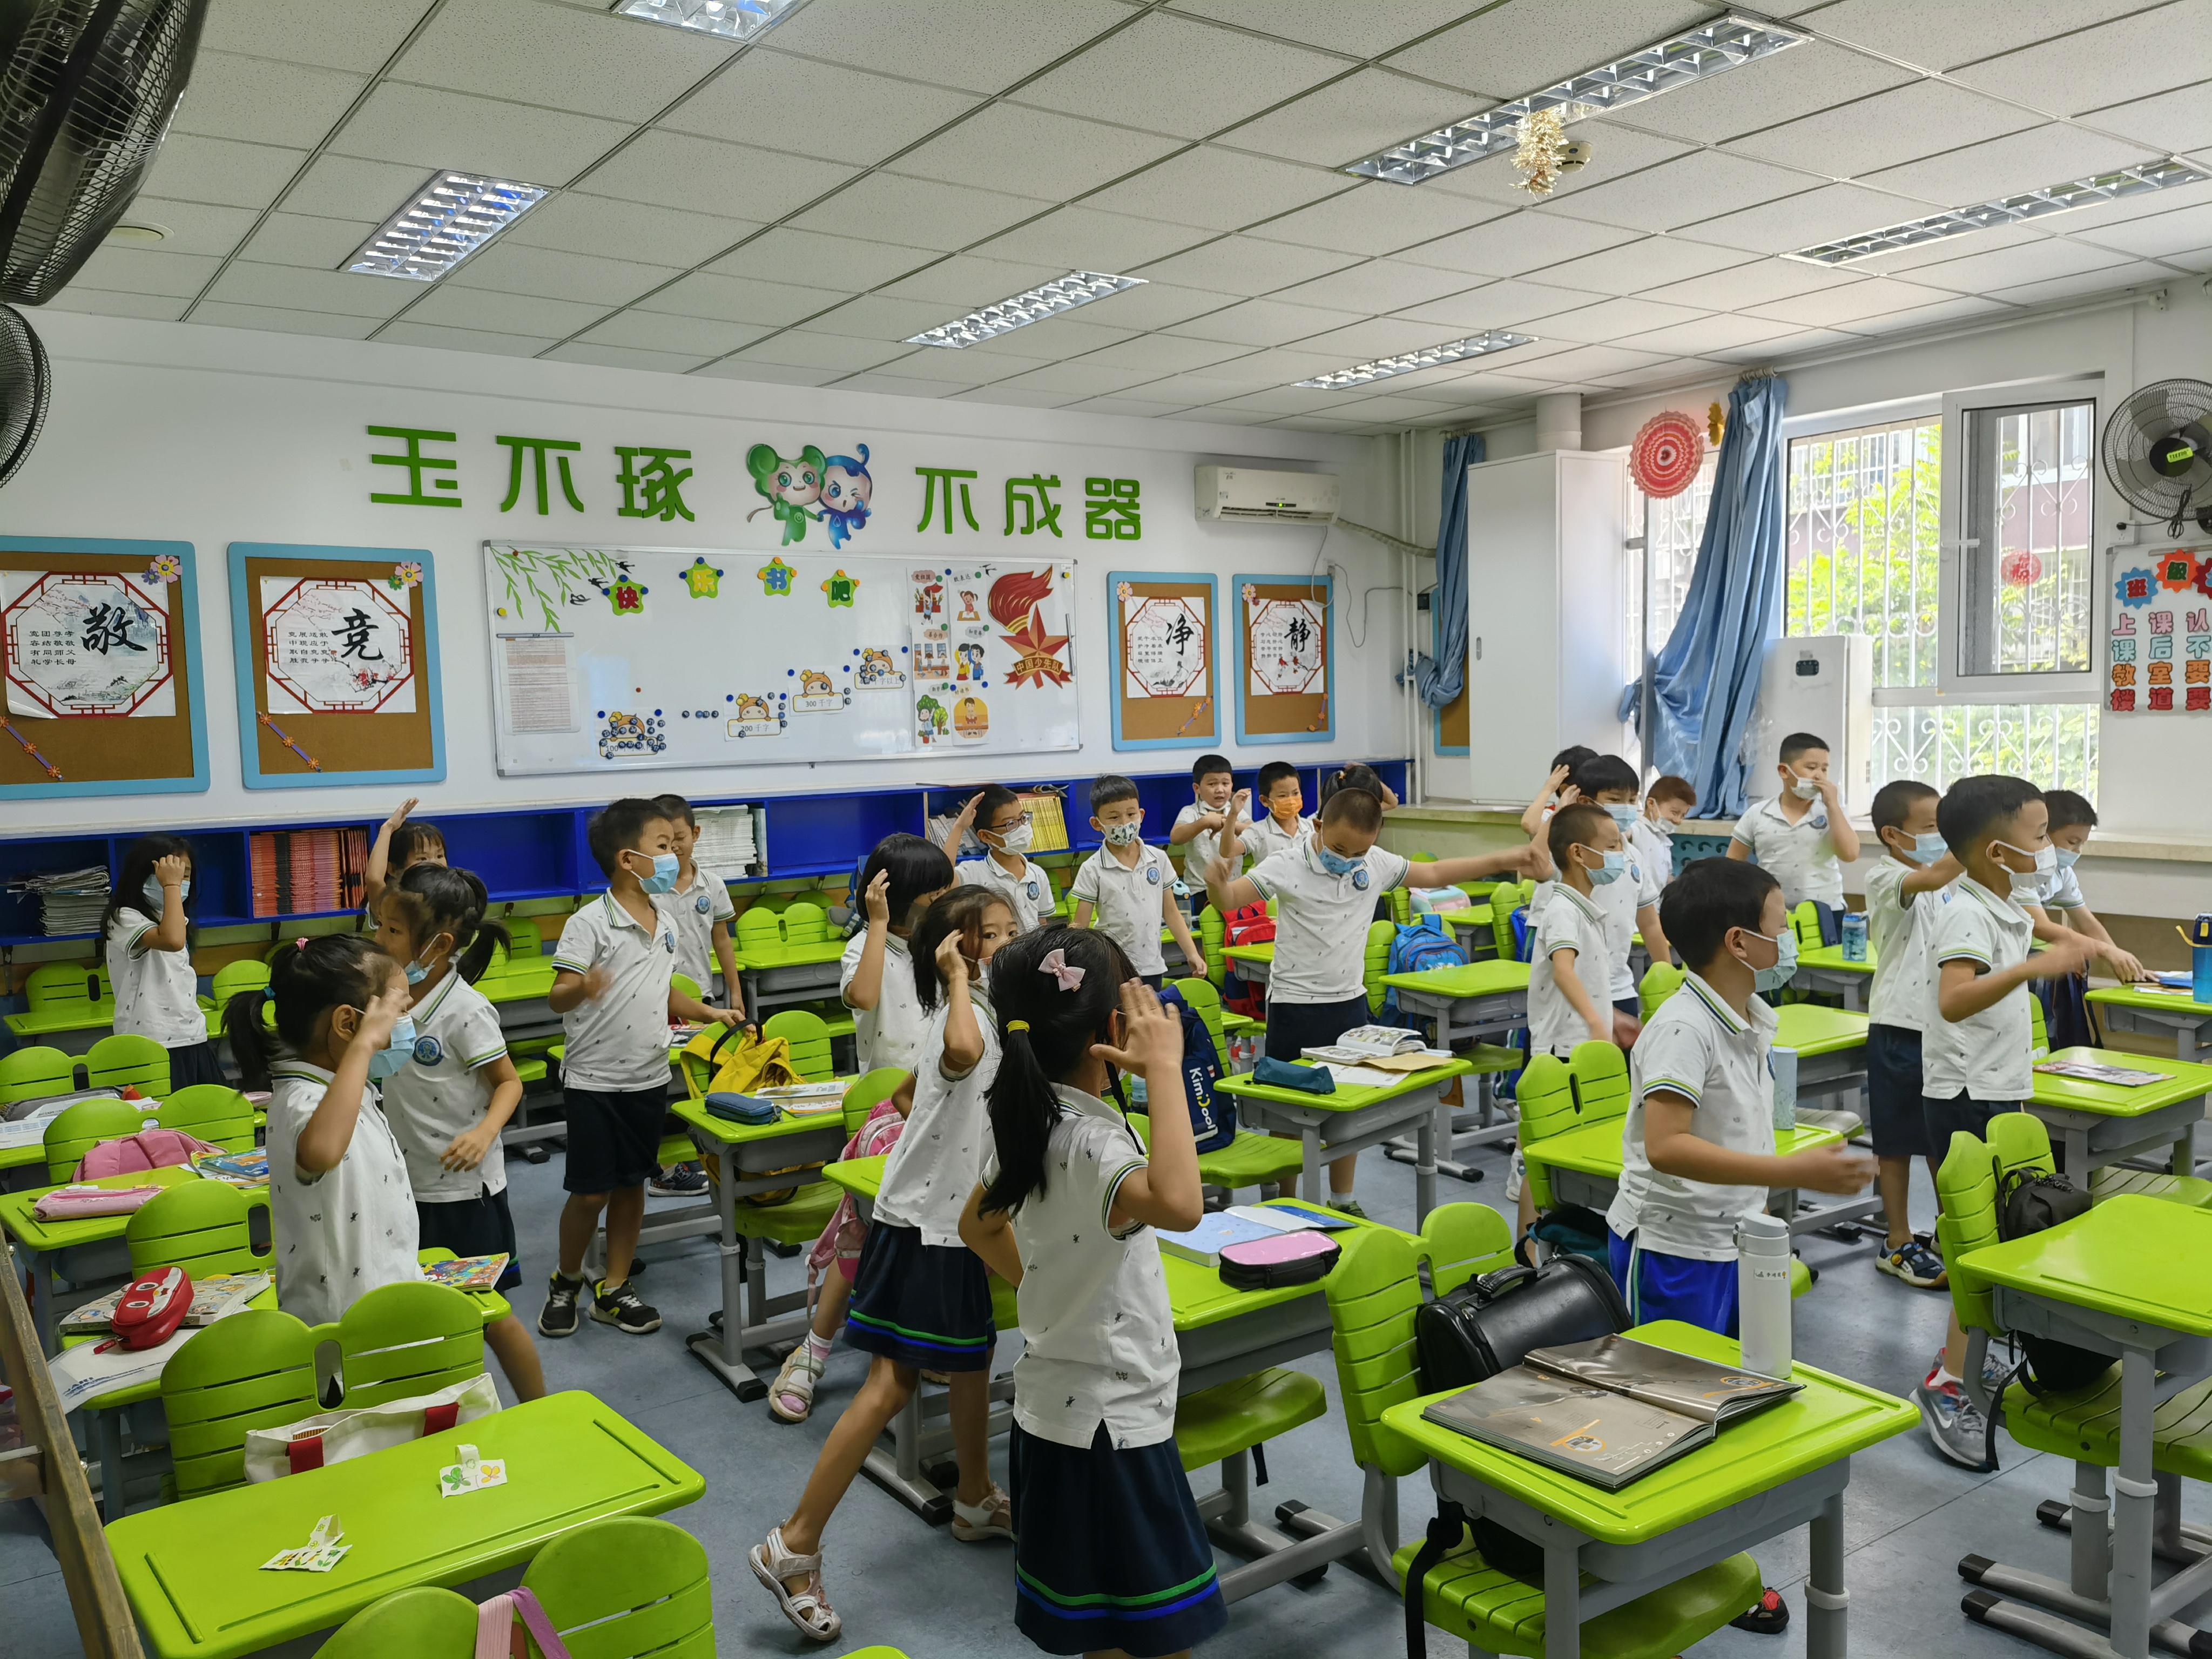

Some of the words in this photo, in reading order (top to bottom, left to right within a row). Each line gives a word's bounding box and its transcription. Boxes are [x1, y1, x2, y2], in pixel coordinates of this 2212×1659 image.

[367, 425, 694, 522] 玉不琢
[915, 466, 1141, 541] 不成器
[80, 602, 148, 656] 敬
[331, 608, 384, 660] 竞
[1165, 613, 1195, 656] 净
[1284, 617, 1311, 652] 静
[2112, 608, 2210, 636] 上课认
[1016, 658, 1059, 672] 中国少先队
[2112, 635, 2211, 662] 课后不
[2112, 659, 2211, 687] 教室要
